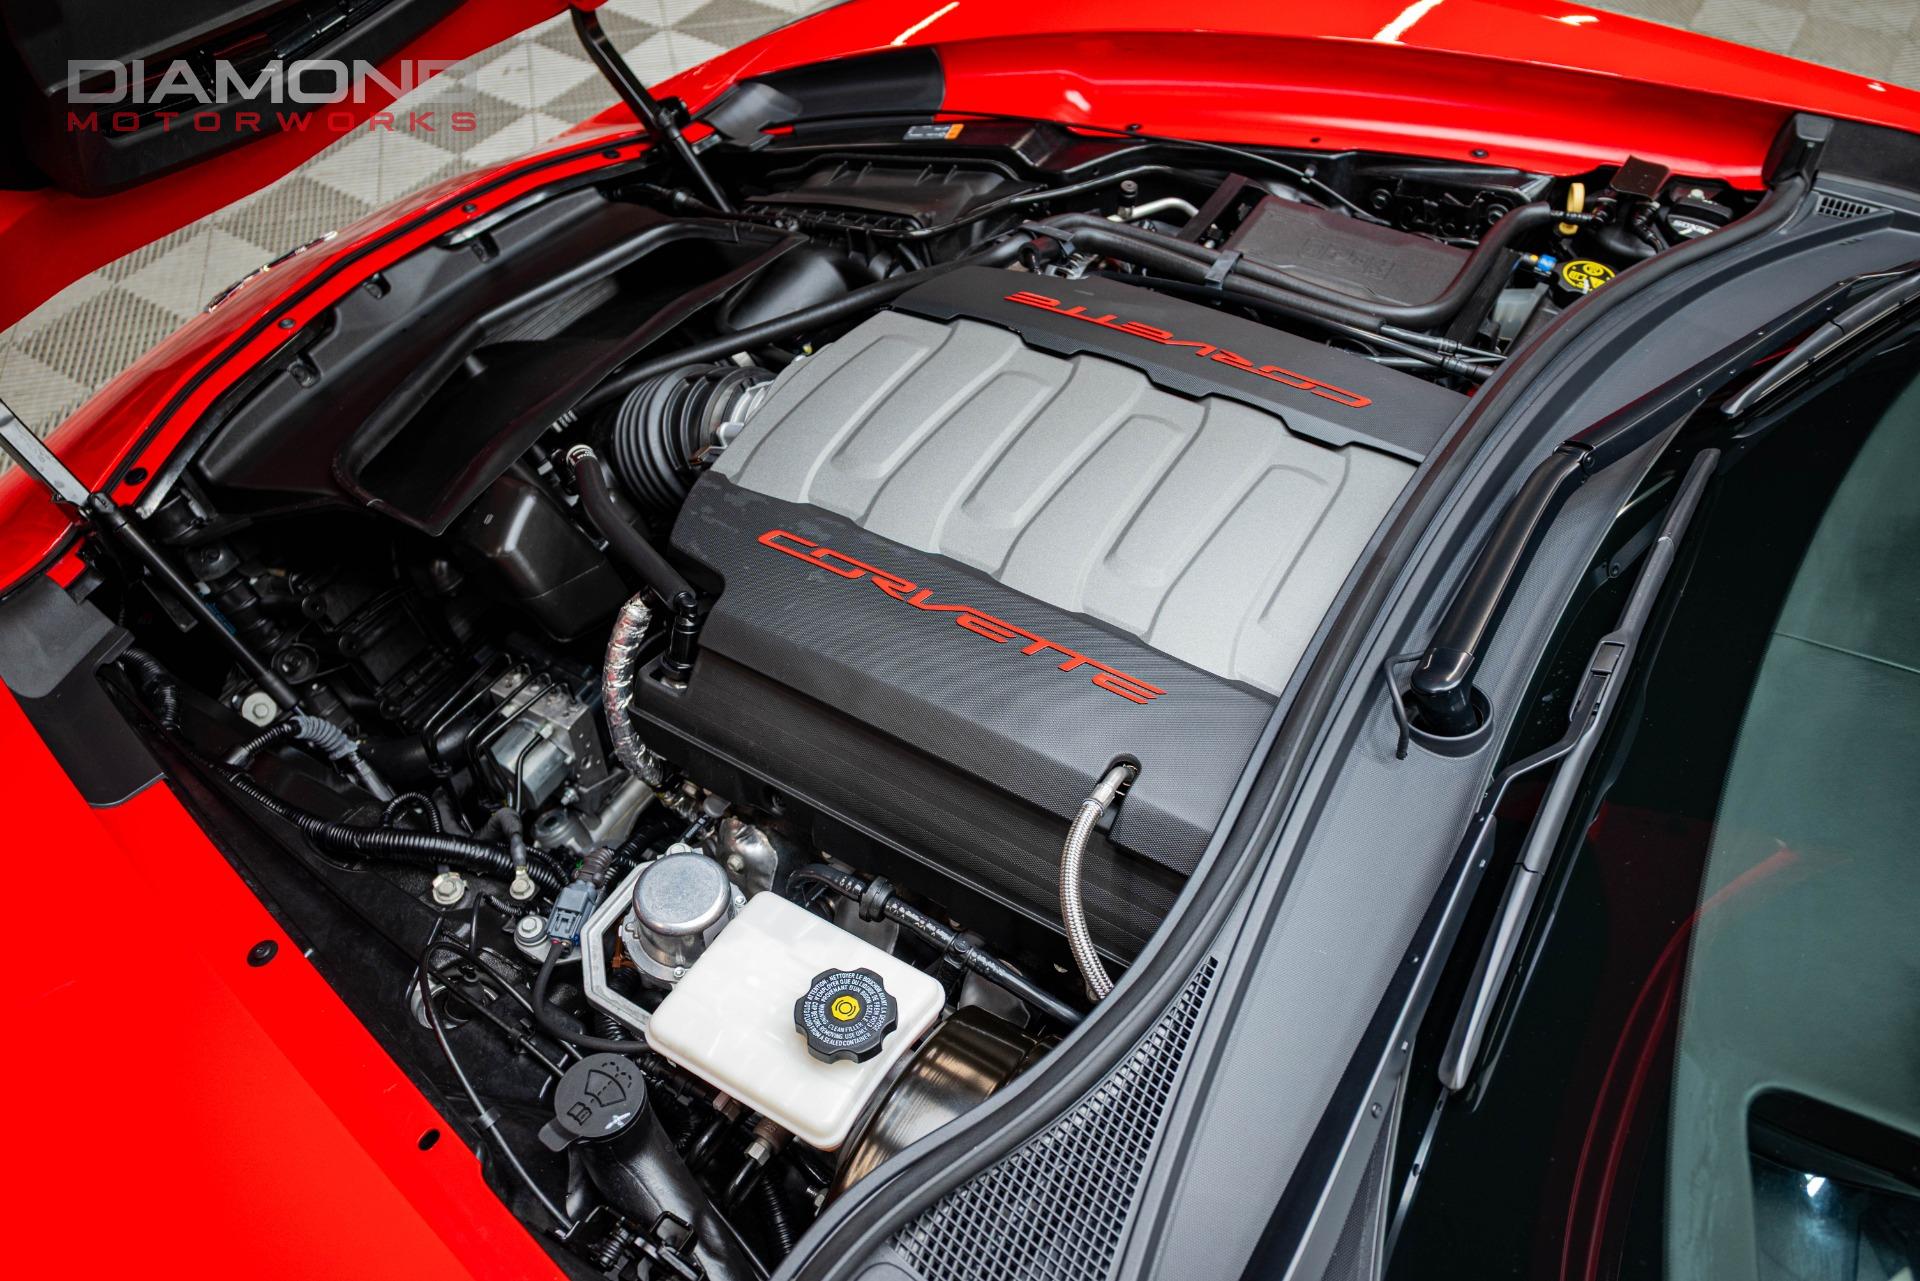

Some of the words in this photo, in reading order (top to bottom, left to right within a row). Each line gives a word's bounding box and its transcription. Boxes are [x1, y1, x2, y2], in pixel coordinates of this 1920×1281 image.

[1004, 291, 1372, 408] CORVETTE
[756, 529, 1167, 704] CORVETTE
[828, 973, 854, 981] NETTOYER
[827, 1023, 845, 1033] CLEAN
